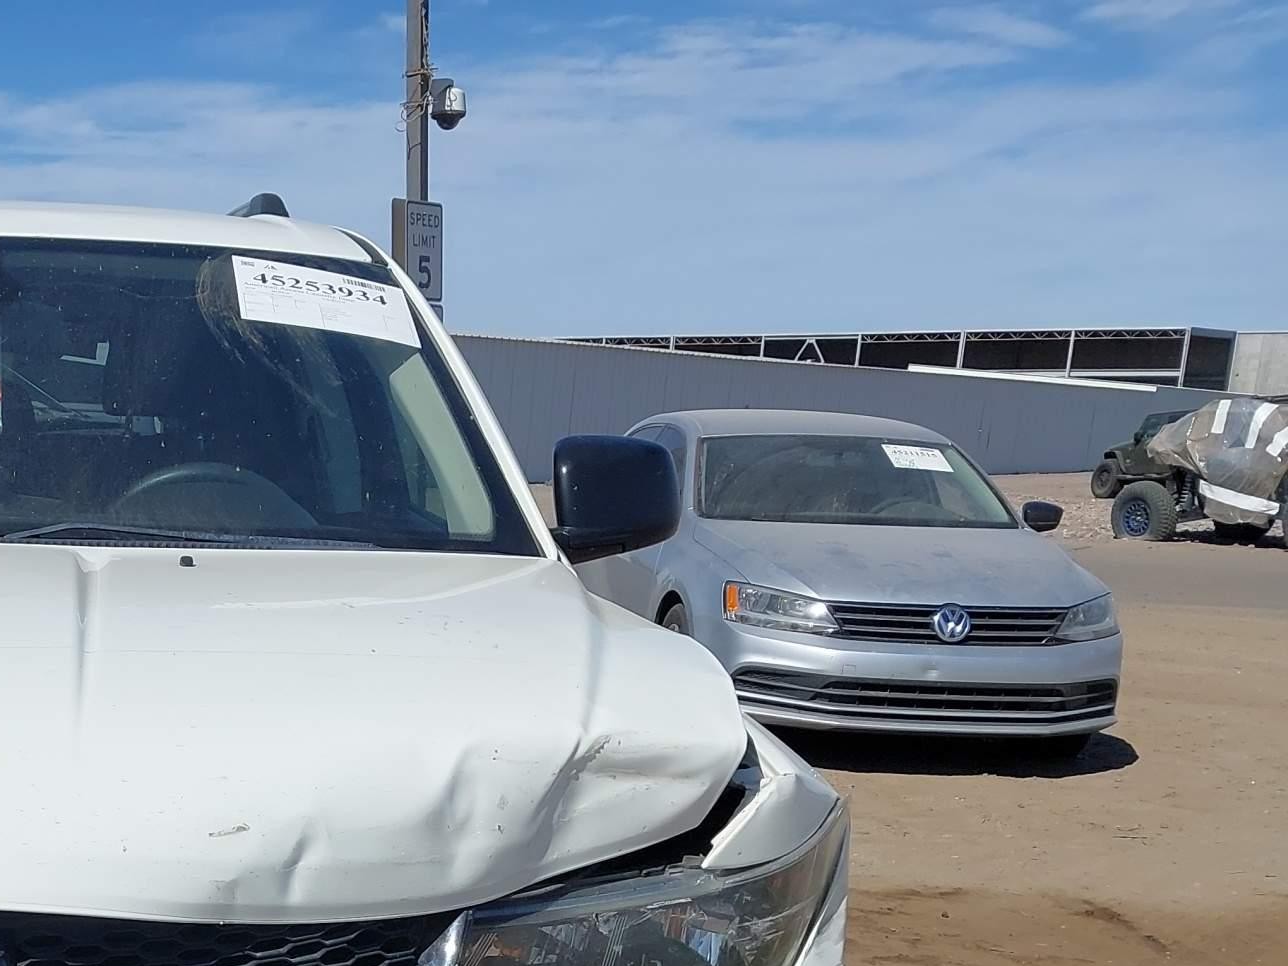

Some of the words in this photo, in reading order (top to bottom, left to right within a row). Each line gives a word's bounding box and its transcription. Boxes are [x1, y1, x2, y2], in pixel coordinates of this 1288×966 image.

[410, 212, 439, 228] SPEED
[413, 232, 435, 249] LIMIT
[419, 255, 431, 289] 5
[253, 273, 387, 305] 45253934
